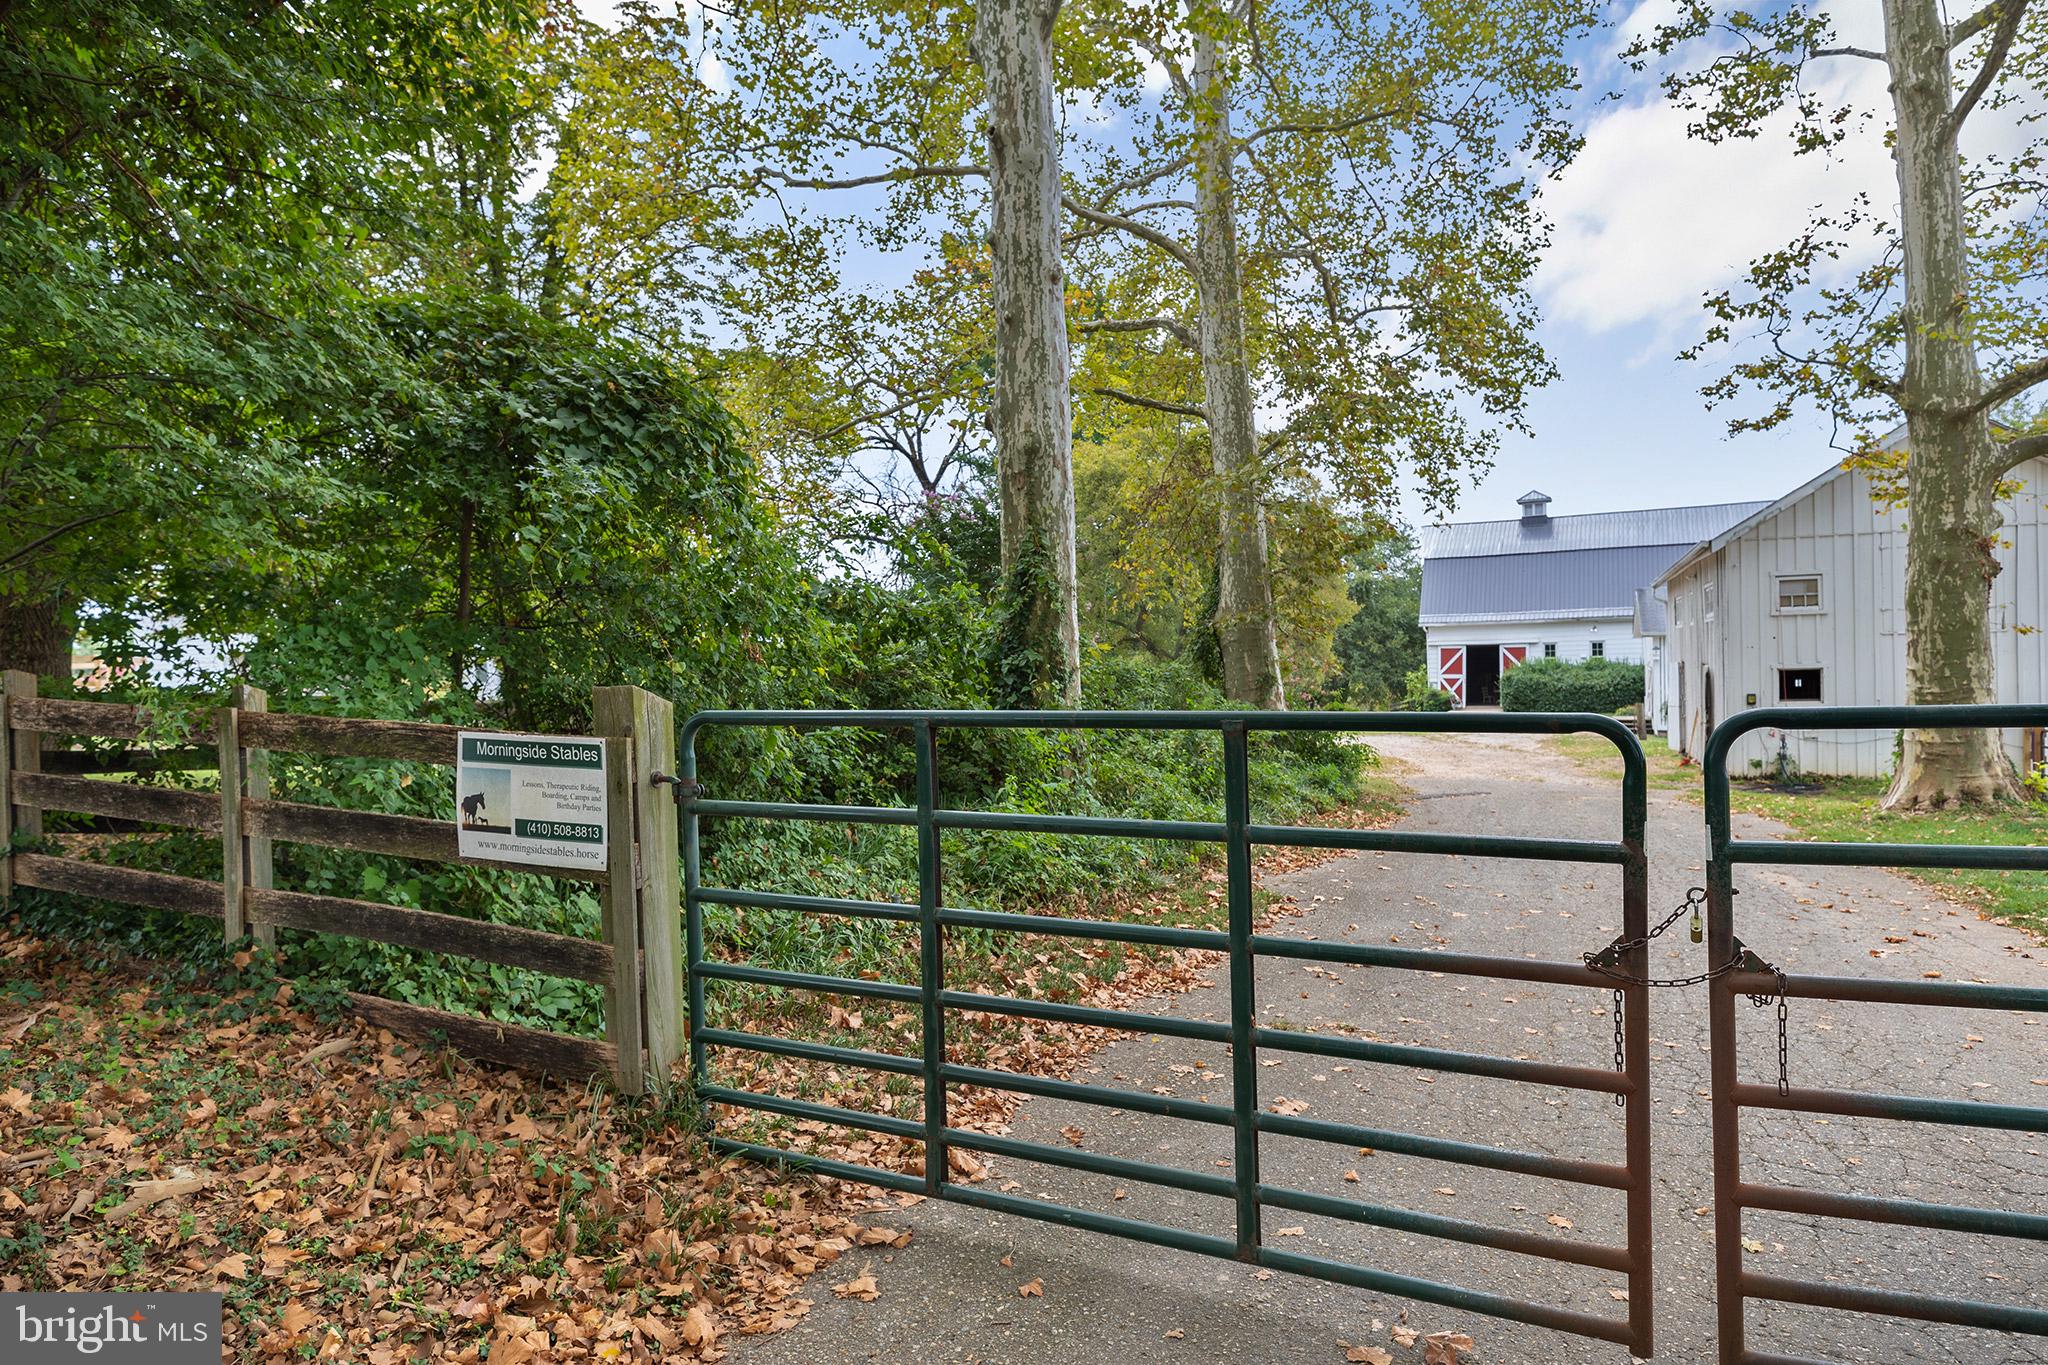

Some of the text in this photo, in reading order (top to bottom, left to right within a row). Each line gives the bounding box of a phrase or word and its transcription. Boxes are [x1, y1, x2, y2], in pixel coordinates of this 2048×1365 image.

[476, 741, 599, 762] Morningside Stables
[522, 780, 601, 793] Lessons, Therapeutic Riding,
[541, 791, 602, 802] Boarding, Camps and
[556, 801, 602, 812] Birthday Parties
[527, 822, 600, 839] (410) 508-8813
[477, 840, 600, 860] www.morningsidestables.horse
